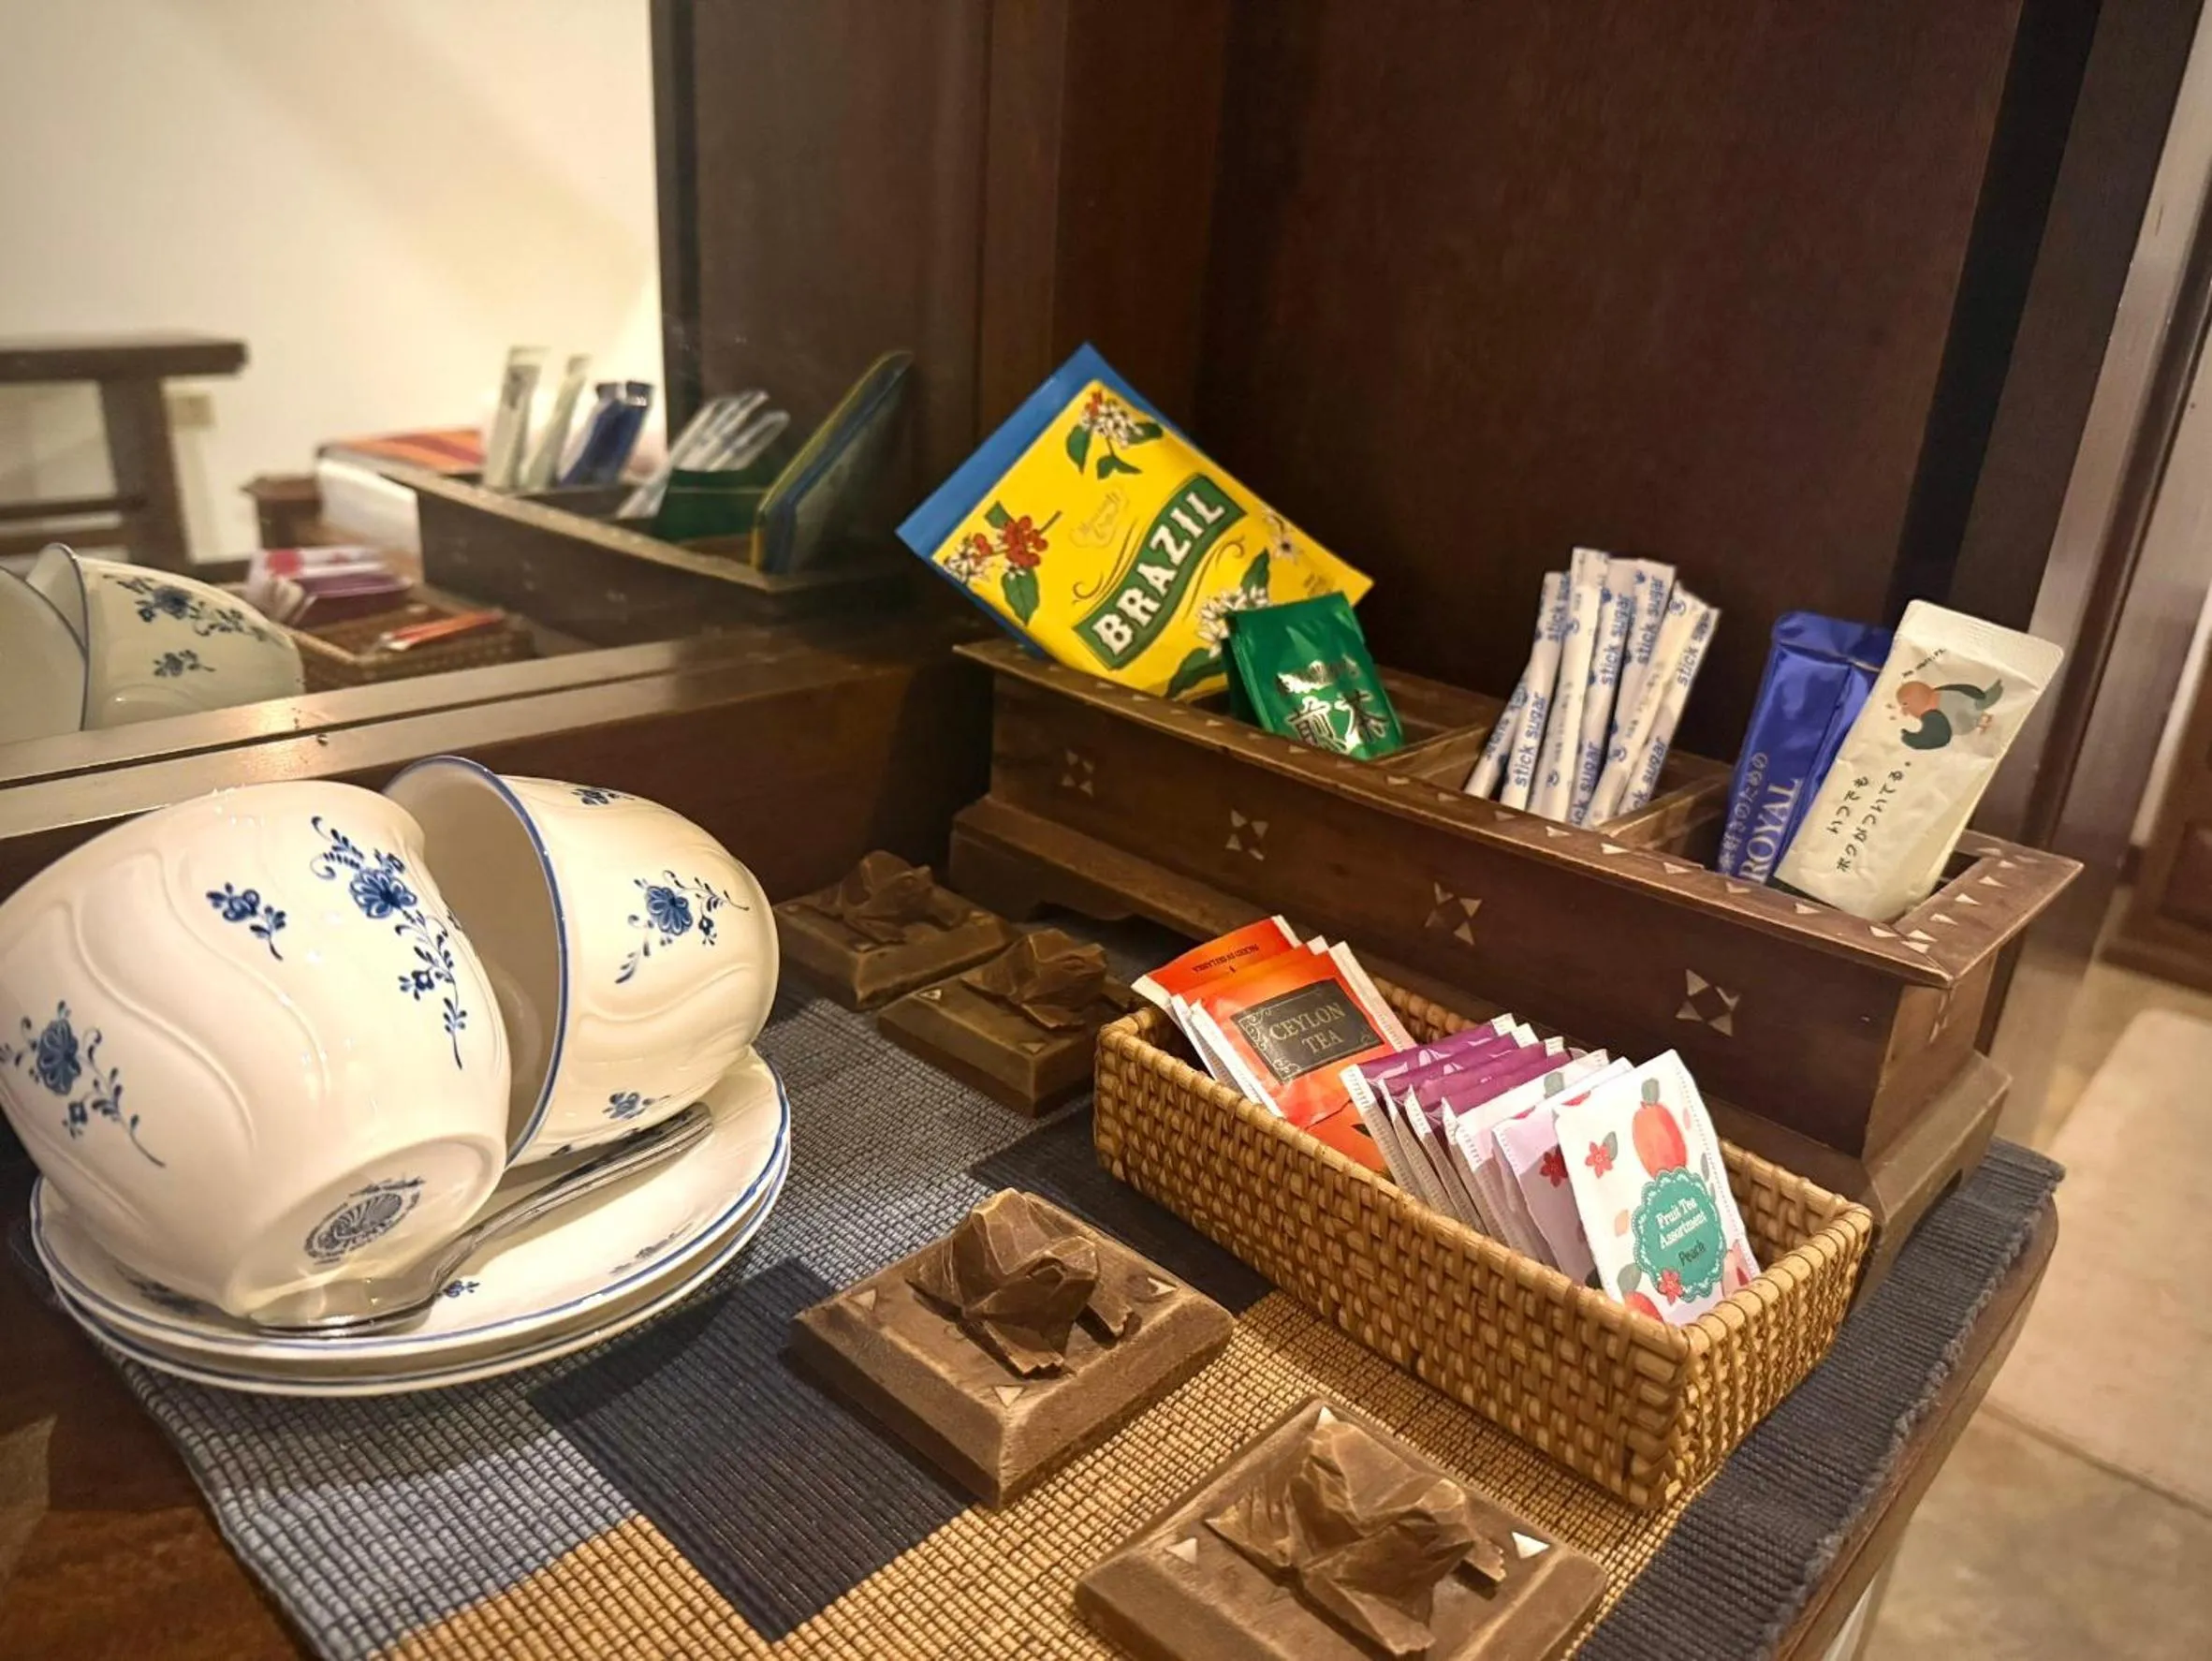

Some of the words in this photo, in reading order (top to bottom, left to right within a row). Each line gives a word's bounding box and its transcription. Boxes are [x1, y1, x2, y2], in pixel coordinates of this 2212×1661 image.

[1091, 492, 1225, 656] BRAZIL
[1647, 574, 1664, 618] sugar
[1600, 644, 1620, 686] stick
[1611, 593, 1631, 638] sugar
[1637, 624, 1658, 666] stick
[1677, 646, 1699, 686] stick
[1524, 691, 1546, 740] sugar
[1515, 744, 1536, 787] stick
[1579, 741, 1598, 793] sugar
[1642, 736, 1667, 787] sugar
[1570, 799, 1590, 826] ick
[1826, 776, 1869, 834] いつでも
[1738, 777, 1805, 885] ROYAL
[1269, 1002, 1346, 1041] CEYLON
[1301, 1029, 1344, 1053] TEA
[1655, 1204, 1681, 1228] Fruit
[1677, 1197, 1697, 1214] Tea
[1659, 1209, 1708, 1250] Assortment
[1678, 1239, 1707, 1267] Peach
